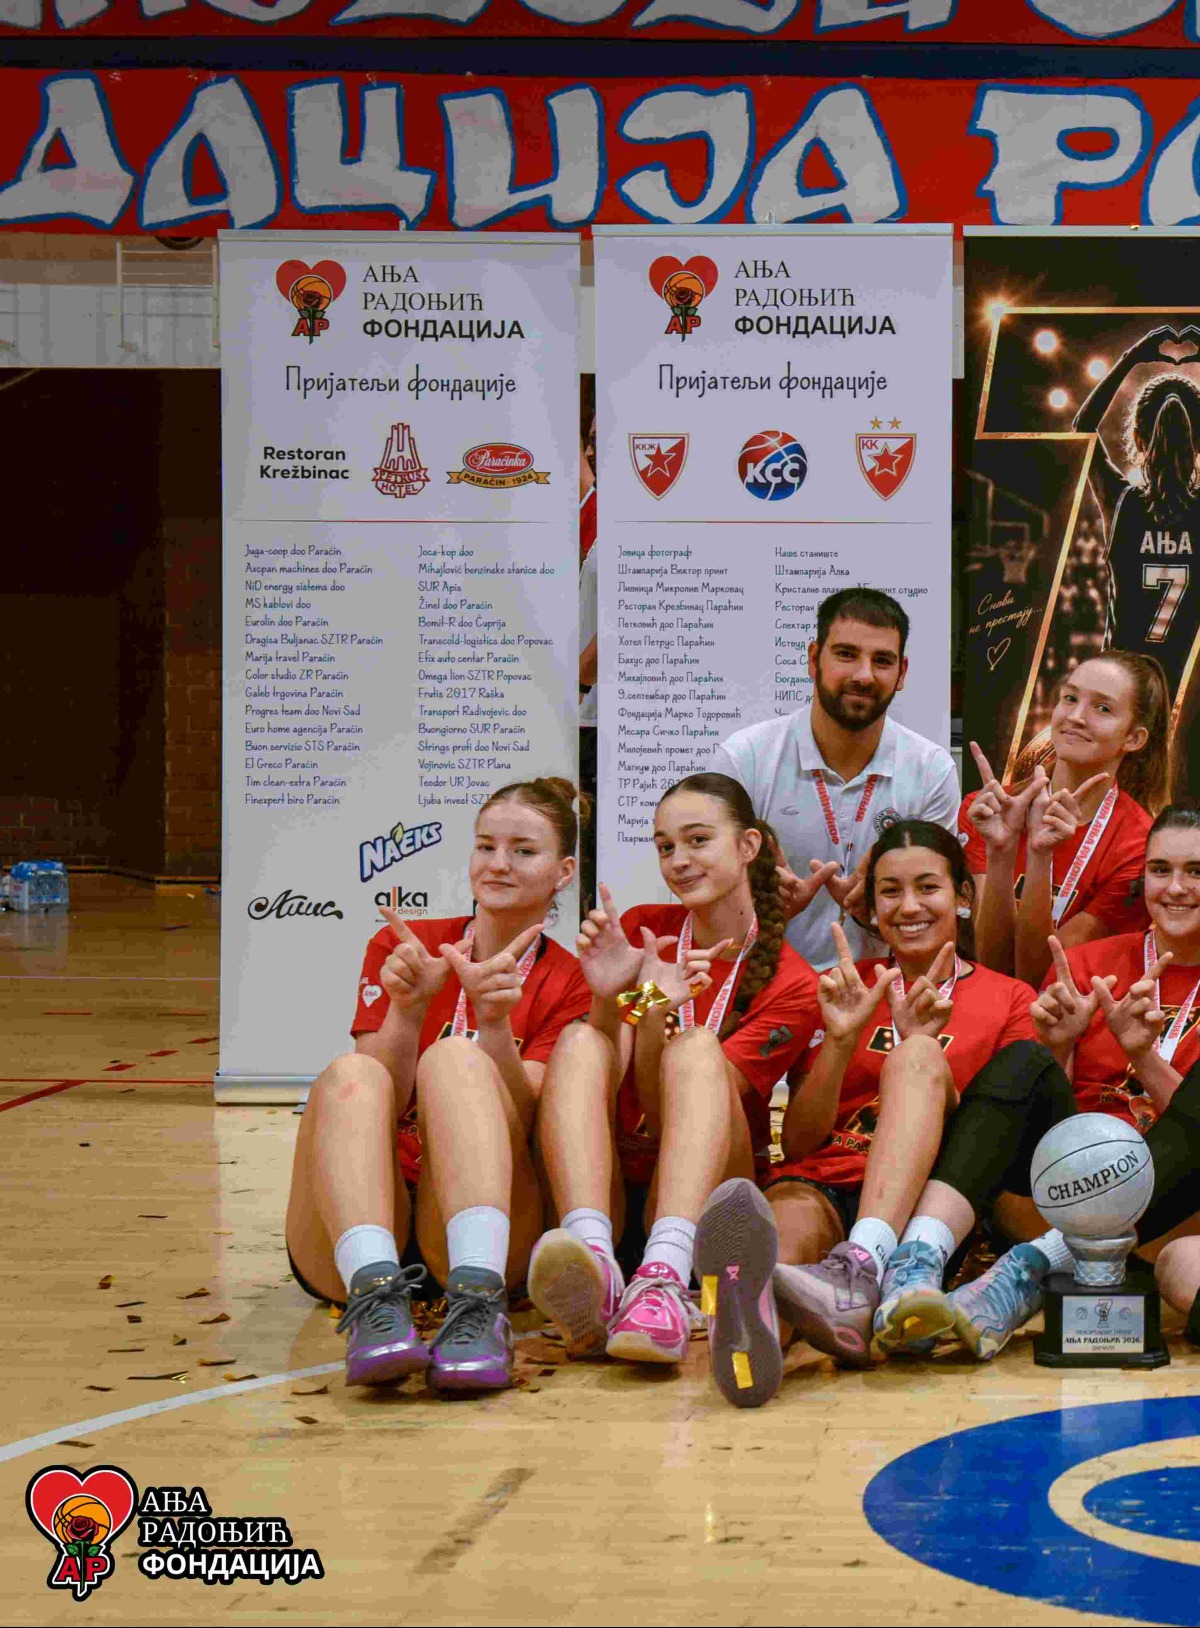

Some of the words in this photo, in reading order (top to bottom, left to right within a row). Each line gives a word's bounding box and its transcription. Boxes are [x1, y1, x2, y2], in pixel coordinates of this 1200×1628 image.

[362, 265, 419, 284] АЊА
[734, 260, 790, 279] АЊА
[362, 292, 484, 314] РАДОЊИЋ
[734, 288, 856, 310] РАДОЊИЋ
[362, 319, 525, 342] ФОНДАЦИЈА
[734, 315, 896, 338] ФОНДАЦИЈА
[285, 365, 400, 401] Пријатељи
[407, 363, 517, 401] фондације
[658, 363, 771, 399] Пријатељи
[779, 361, 888, 399] фондације
[262, 446, 347, 461] Restoran
[259, 464, 350, 480] Krežbinac
[511, 472, 534, 485] 1924
[380, 481, 419, 493] HOTEL
[1139, 531, 1194, 556] АЊА
[1142, 563, 1190, 643] 7
[374, 886, 428, 907] alka
[397, 907, 428, 917] design
[1047, 1150, 1139, 1201] CHAMPION
